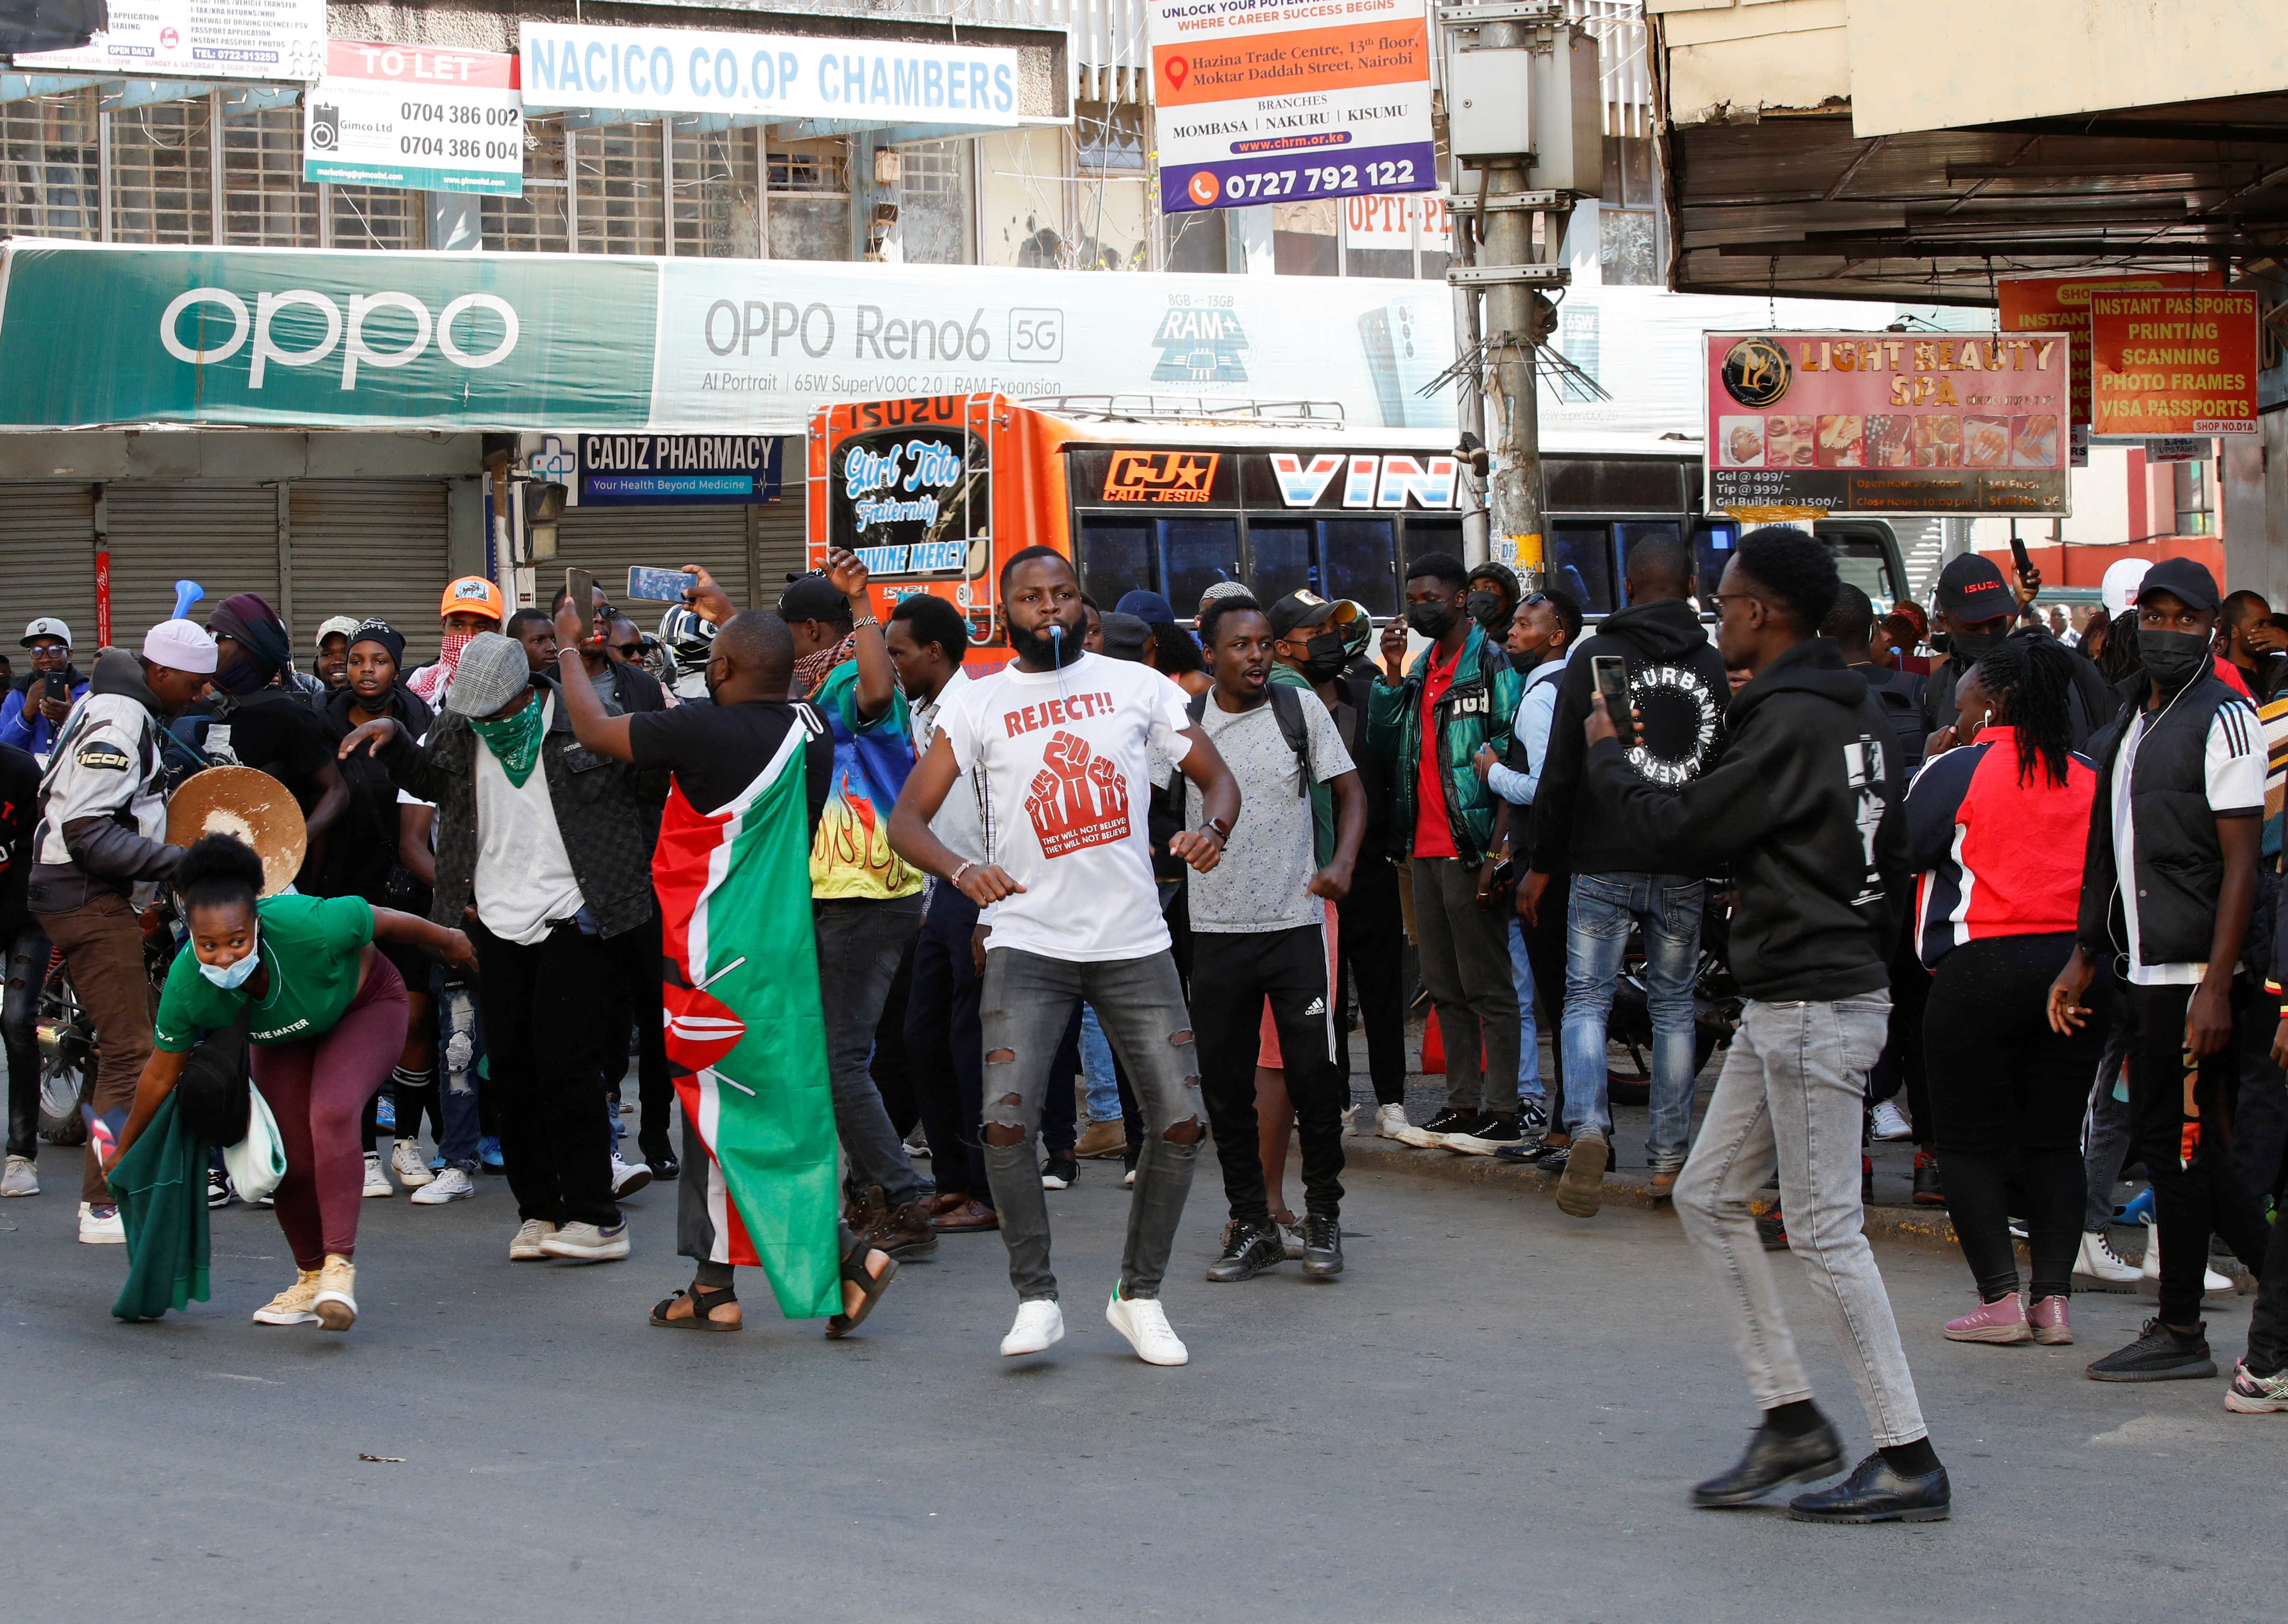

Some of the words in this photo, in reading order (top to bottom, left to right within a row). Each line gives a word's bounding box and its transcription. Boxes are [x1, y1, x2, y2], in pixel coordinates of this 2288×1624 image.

[114, 12, 159, 21] APPLICATION
[227, 8, 275, 17] RETURNS/NHIF
[1162, 3, 1216, 19] UNLOCK
[1219, 0, 1255, 13] YOUR
[1177, 18, 1225, 31] WHERE
[1228, 12, 1280, 26] CAREER
[1283, 6, 1342, 20] SUCCESS
[1347, 0, 1395, 14] BEGINS
[191, 27, 225, 35] PASSPORT
[109, 46, 131, 55] OPEN
[131, 47, 153, 56] DAILY
[195, 49, 215, 59] TEL:
[218, 50, 277, 62] 0722-813255
[1192, 55, 1242, 70] Hazina
[1246, 49, 1287, 64] Trade
[1291, 44, 1344, 59] Centre,
[1349, 37, 1374, 54] 13th
[1378, 36, 1419, 50] floor,
[19, 53, 73, 62] MONDAY-FRIDAY
[181, 62, 215, 70] SATURDAY
[360, 49, 405, 76] TO
[415, 54, 475, 80] LET
[1193, 71, 1244, 87] Moktar
[1249, 64, 1304, 80] Daddah
[1308, 59, 1354, 75] Street,
[1358, 52, 1413, 70] Nairobi
[531, 38, 674, 96] NACICO
[688, 47, 798, 101] CO.OP
[818, 53, 1013, 113] CHAMBERS
[1257, 95, 1328, 111] BRANCHES
[401, 102, 443, 122] 0704
[449, 105, 481, 125] 386
[486, 107, 518, 127] 002
[1173, 120, 1249, 139] MOMBASA
[1265, 112, 1330, 130] NAKURU
[1347, 104, 1409, 122] KISUMU
[340, 120, 373, 132] Gimco
[376, 122, 393, 133] Ltd
[400, 136, 443, 156] 0704
[448, 138, 481, 158] 386
[486, 141, 518, 160] 004
[1239, 132, 1345, 152] www.chrm.or.ke
[317, 168, 404, 181] marketing@gimcoltd.com
[443, 176, 506, 187] www.gimcoltd.com
[1226, 170, 1297, 200] 0727
[1305, 165, 1359, 192] 792
[1365, 159, 1415, 187] 122
[1168, 293, 1191, 307] 8GB
[1207, 295, 1234, 308] 13GB
[2095, 298, 2161, 315] INSTANT
[2166, 298, 2253, 314] PASSPORTS
[705, 299, 834, 358] OPPO
[856, 304, 990, 361] Reno6
[1016, 320, 1056, 351] 5G
[1163, 310, 1238, 339] RAM+
[1567, 314, 1595, 330] 65W
[160, 287, 519, 390] oppo
[2129, 323, 2218, 340] PRINTING
[1801, 341, 1905, 372] LIGHT
[1914, 340, 2055, 371] BEAUTY
[2122, 348, 2220, 365] SCANNING
[703, 372, 718, 391] AI
[722, 373, 778, 392] Portrait
[795, 373, 828, 392] 65W
[832, 375, 917, 397] SuperVOOC
[921, 376, 942, 393] 2.0
[955, 376, 986, 394] RAM
[991, 378, 1061, 397] Expansion
[2102, 374, 2164, 391] PHOTO
[2172, 374, 2245, 390] FRAMES
[1890, 376, 1959, 407] SPA
[1966, 395, 2001, 405] CONTACT
[851, 396, 953, 429] ISUZU
[2101, 400, 2142, 417] VISA
[2147, 400, 2249, 416] PASSPORTS
[2222, 423, 2253, 431] NO.D1A
[586, 437, 650, 470] CADIZ
[656, 437, 774, 470] PHARMACY
[845, 444, 902, 499] Girl
[1716, 472, 1736, 481] Gel
[1739, 472, 1751, 483] @
[1753, 471, 1790, 482] 499/-
[594, 480, 617, 490] Your
[621, 480, 654, 490] Health
[658, 480, 696, 492] Beyond
[699, 480, 745, 490] Medicine
[1716, 484, 1736, 495] Tip
[1739, 484, 1751, 495] @
[1753, 484, 1790, 495] 999/-
[1857, 480, 1884, 488] Open
[1988, 480, 2007, 489] 1st
[2009, 480, 2041, 489] Floor
[1103, 490, 1144, 502] CALL
[1152, 490, 1210, 502] JESUS
[1716, 497, 1736, 506] Gel
[1738, 497, 1783, 506] Builder
[1785, 497, 1798, 506] @
[1800, 497, 1843, 507] 1500/-
[1857, 498, 1885, 506] Close
[1989, 495, 2017, 506] Stall
[855, 494, 939, 533] Fraternity
[906, 540, 967, 572] MERCY
[1964, 580, 2001, 593] ISUZU
[1003, 692, 1115, 739] REJECT!!
[563, 742, 582, 753] FUTURE
[1042, 835, 1060, 846] THEY
[1060, 829, 1079, 842] WILL
[1081, 825, 1097, 835] NOT
[1099, 817, 1127, 831] BELIEVE!
[1045, 843, 1063, 855] THEY
[1064, 838, 1081, 850] WILL
[1082, 834, 1099, 844] NOT
[1102, 826, 1127, 840] BELIEVE!
[1305, 1007, 1325, 1016] adidas
[250, 1030, 272, 1041] THE
[273, 1018, 310, 1039] MATER
